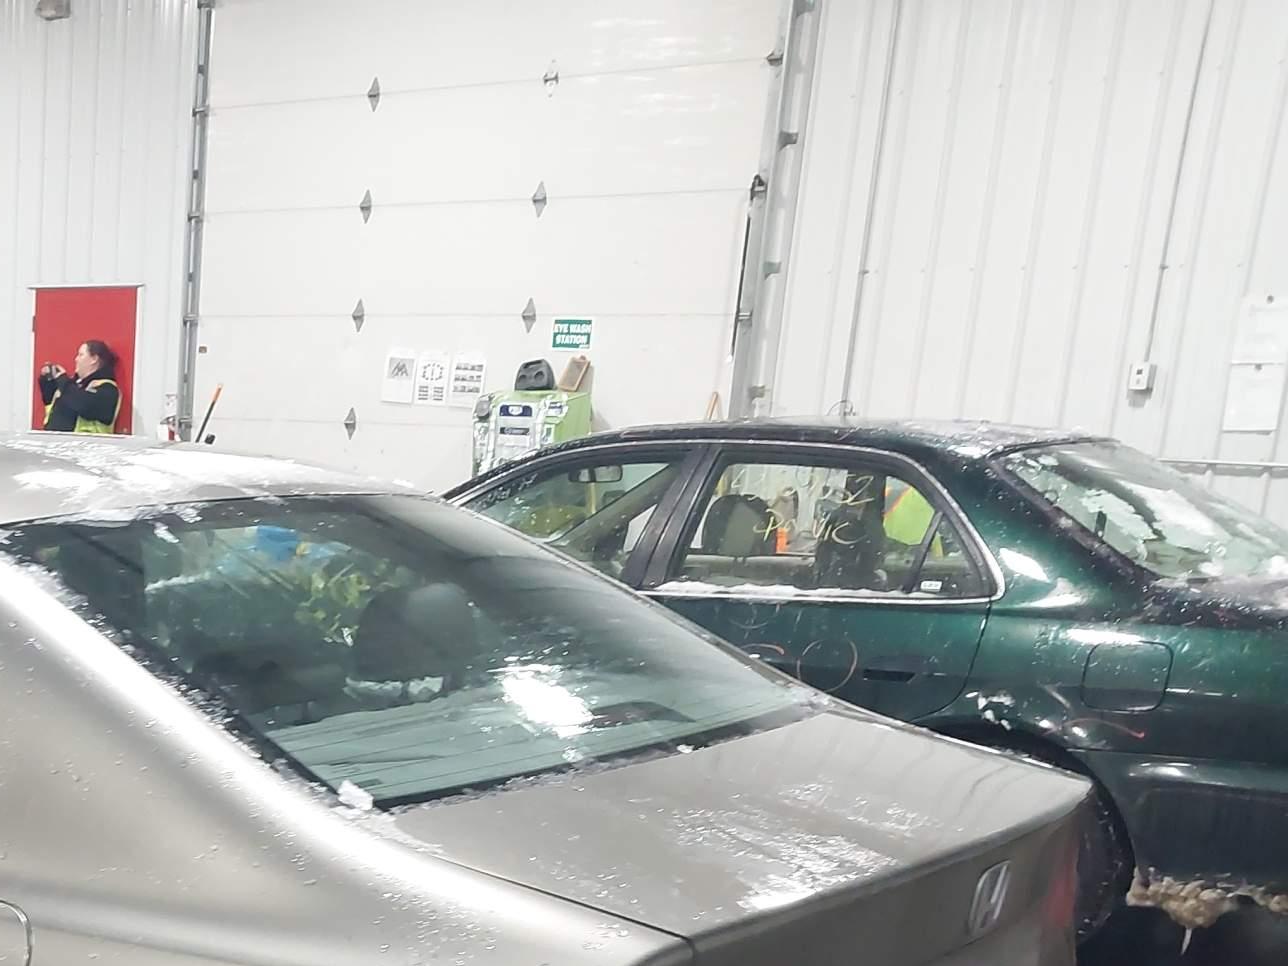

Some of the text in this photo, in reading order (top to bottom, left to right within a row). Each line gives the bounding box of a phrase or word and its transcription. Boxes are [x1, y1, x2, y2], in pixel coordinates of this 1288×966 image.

[554, 323, 592, 334] EYE WASH
[555, 334, 589, 345] STATION
